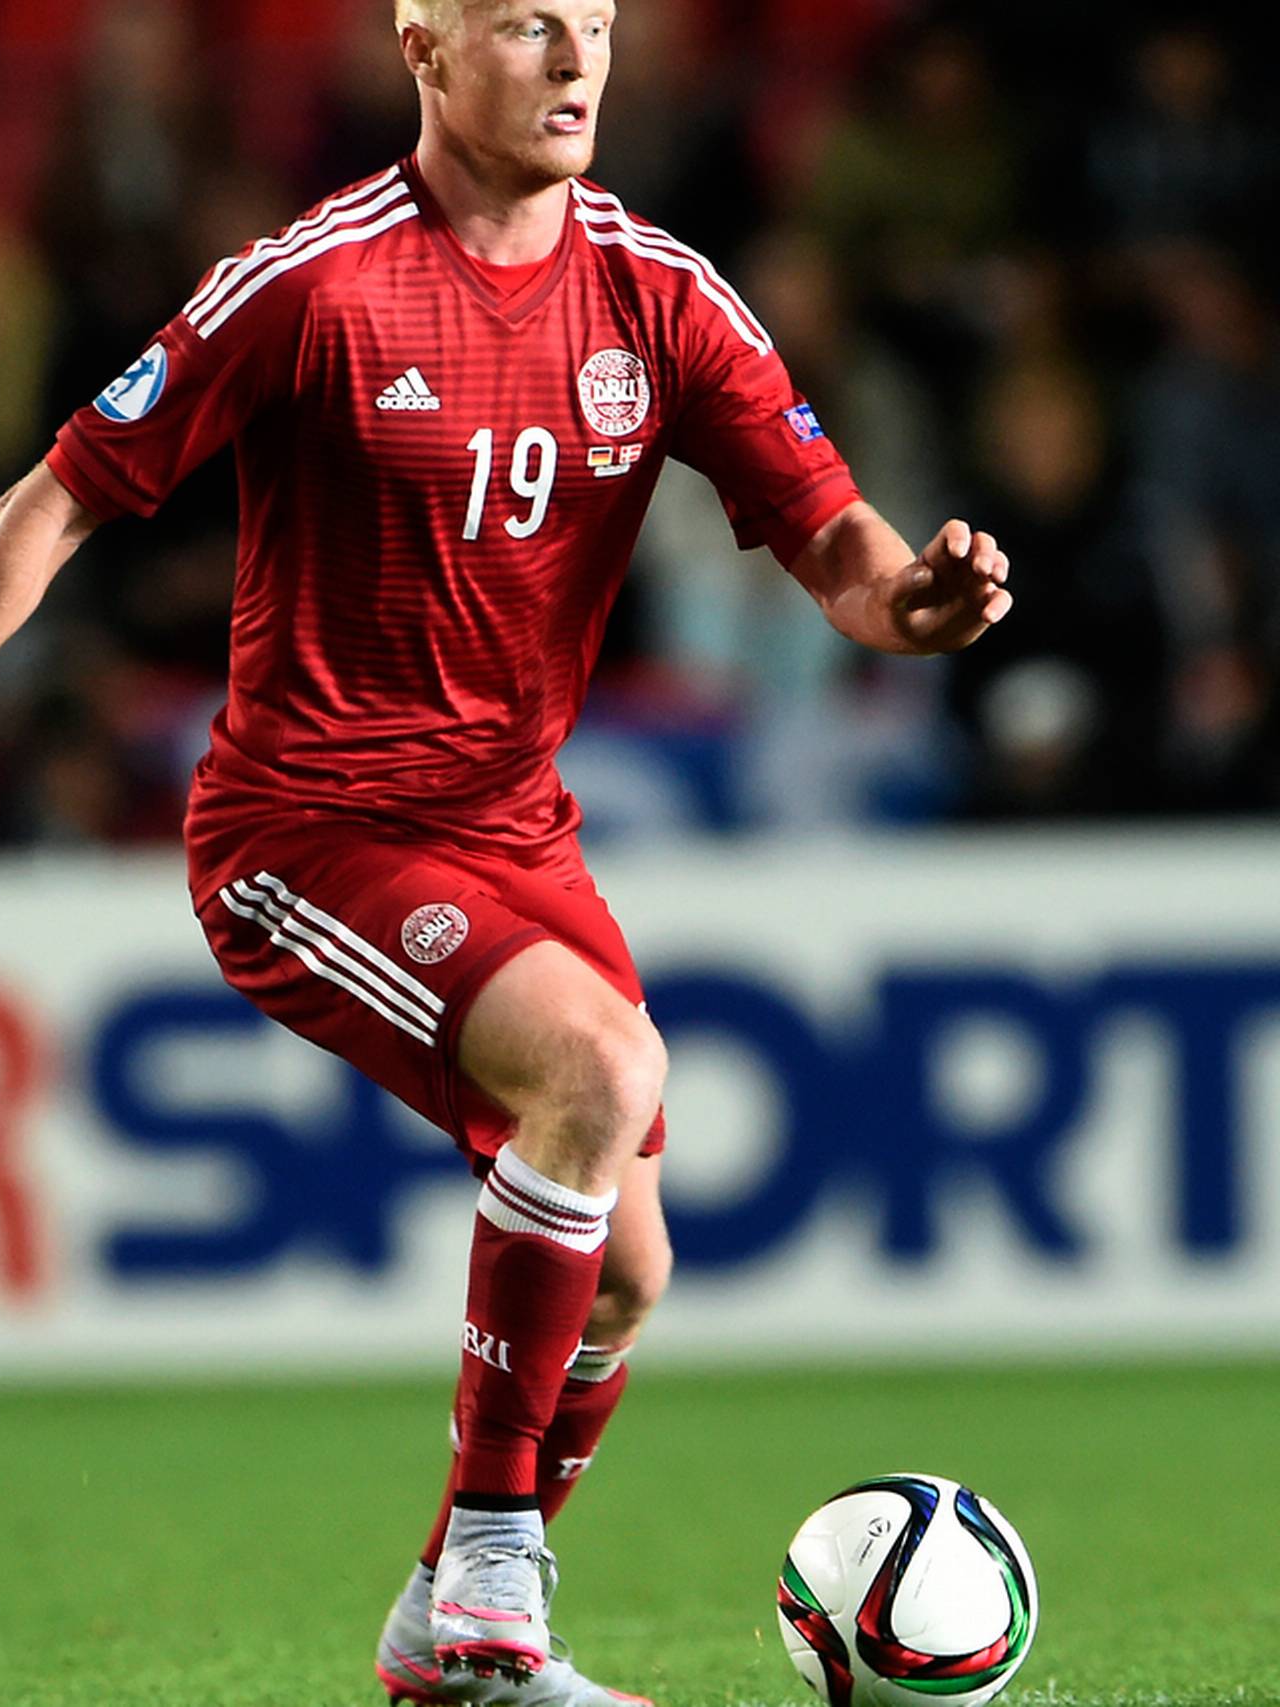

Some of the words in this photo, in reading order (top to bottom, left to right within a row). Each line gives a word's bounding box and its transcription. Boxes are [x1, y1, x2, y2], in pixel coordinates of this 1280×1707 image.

[376, 392, 440, 410] adidas
[592, 379, 638, 403] DBU
[462, 426, 558, 540] 19
[415, 914, 453, 949] DBU
[463, 1321, 512, 1373] BU
